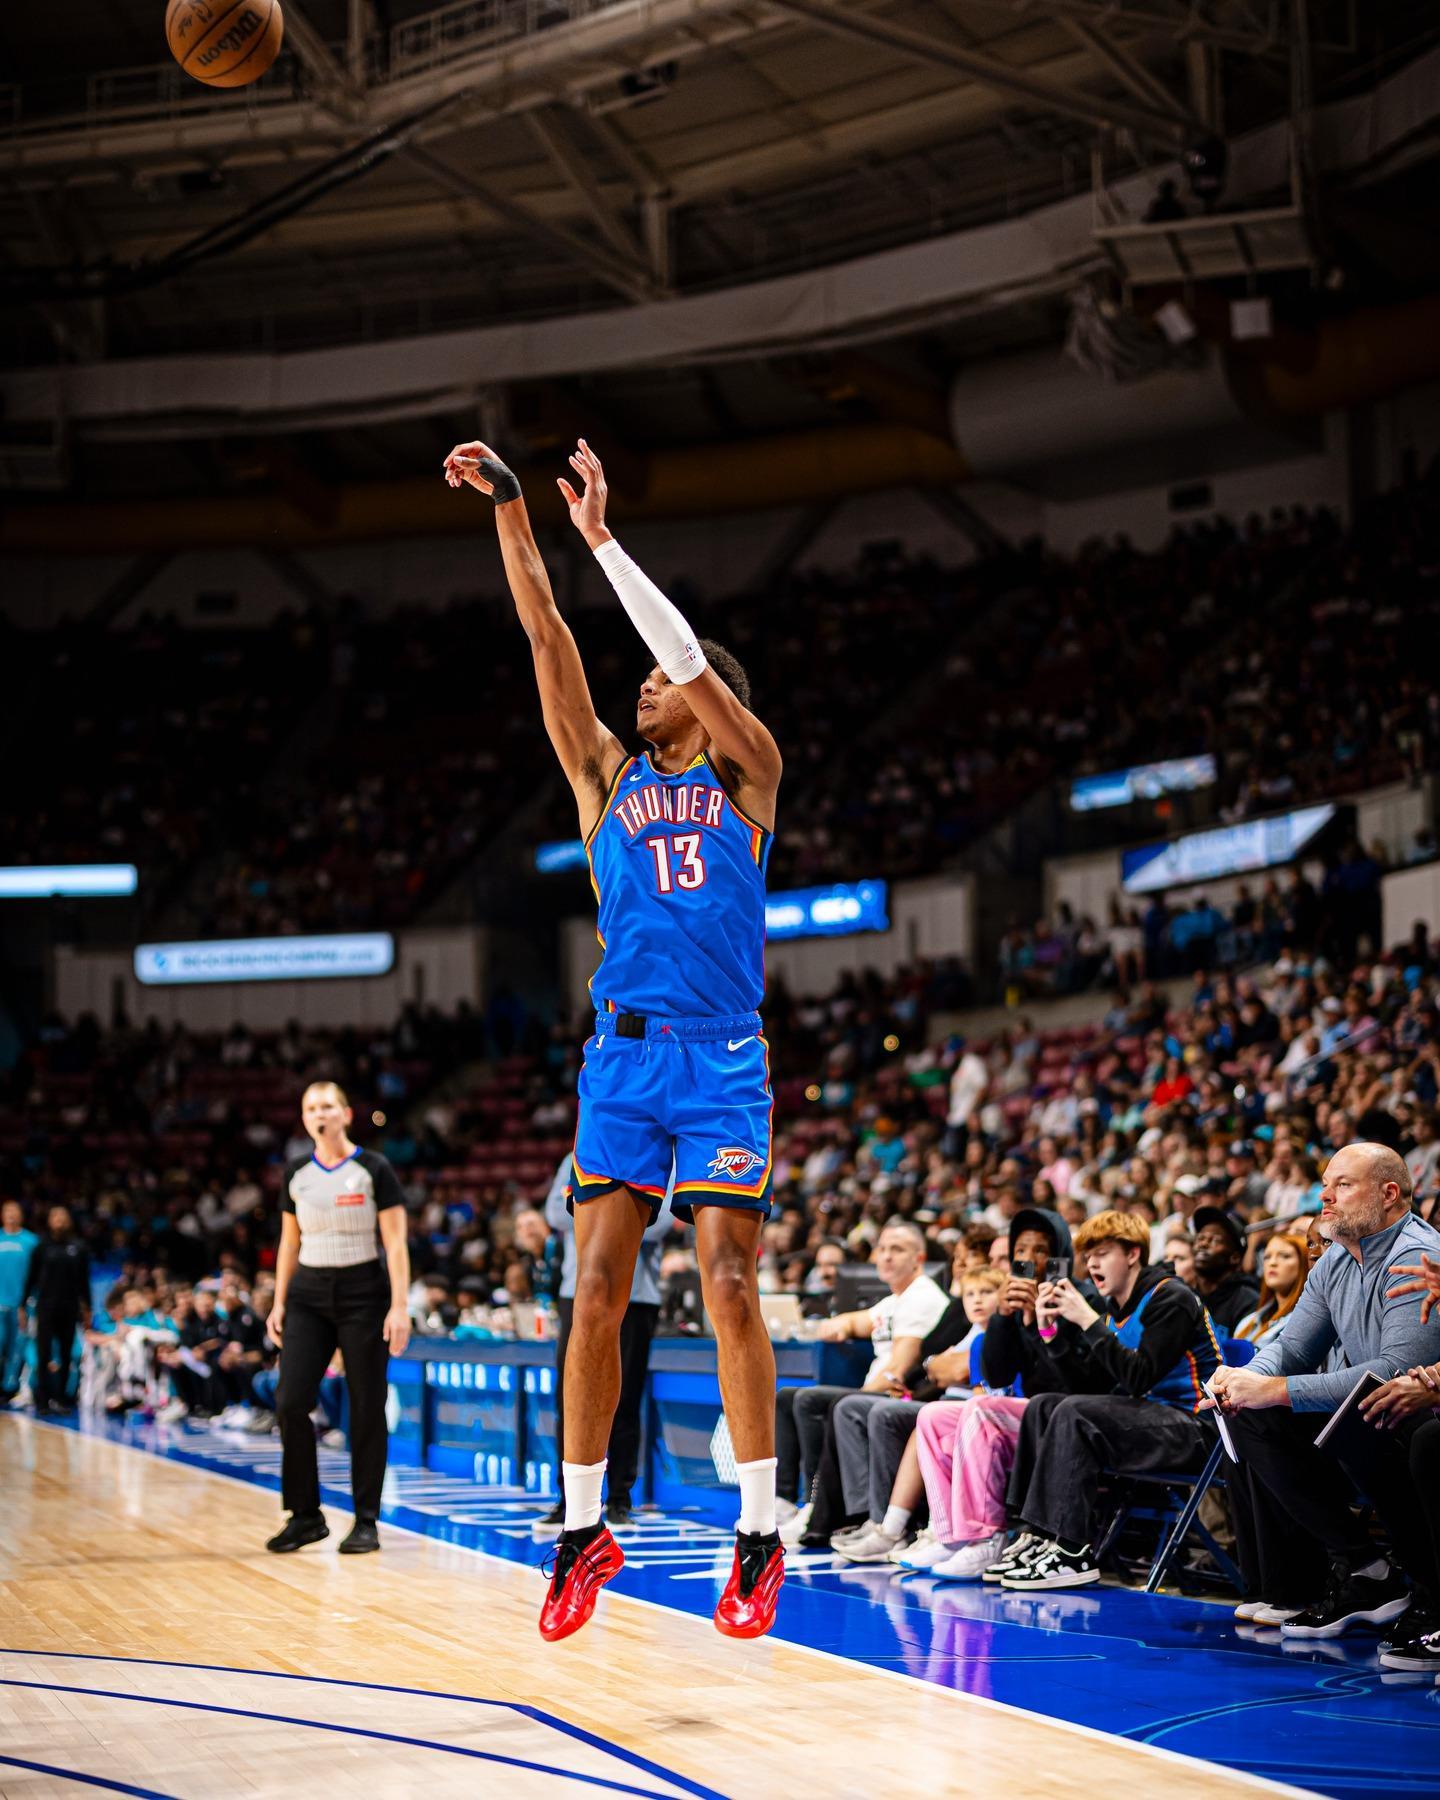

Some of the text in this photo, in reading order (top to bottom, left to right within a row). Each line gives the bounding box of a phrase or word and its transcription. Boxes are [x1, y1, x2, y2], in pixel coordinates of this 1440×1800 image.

[198, 10, 263, 66] Wilson
[613, 784, 725, 838] THUNDER
[646, 831, 706, 894] 13
[717, 1154, 749, 1170] OKC
